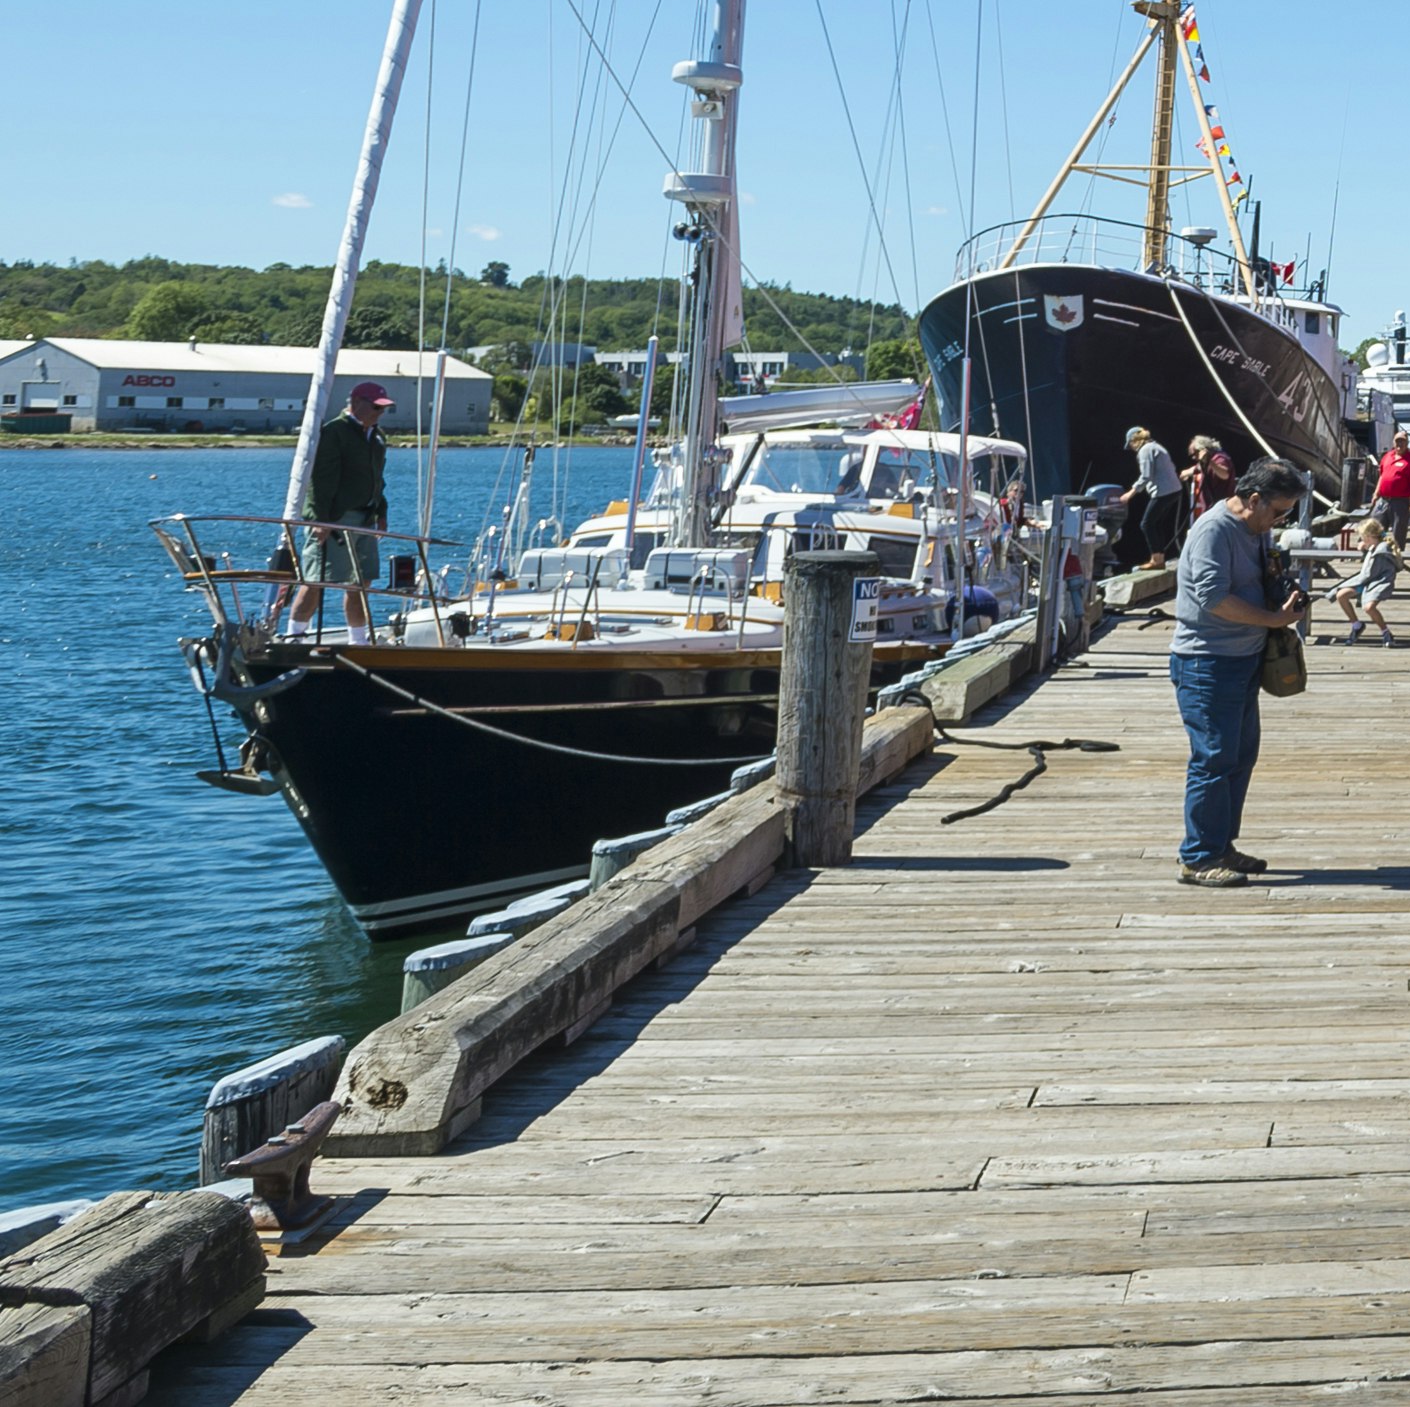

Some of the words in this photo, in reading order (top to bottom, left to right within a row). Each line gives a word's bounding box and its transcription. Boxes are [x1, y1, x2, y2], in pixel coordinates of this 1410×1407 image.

[1210, 345, 1240, 365] CAPE
[1241, 356, 1271, 377] SABLE
[121, 374, 176, 388] ABCO
[1277, 371, 1313, 422] 43
